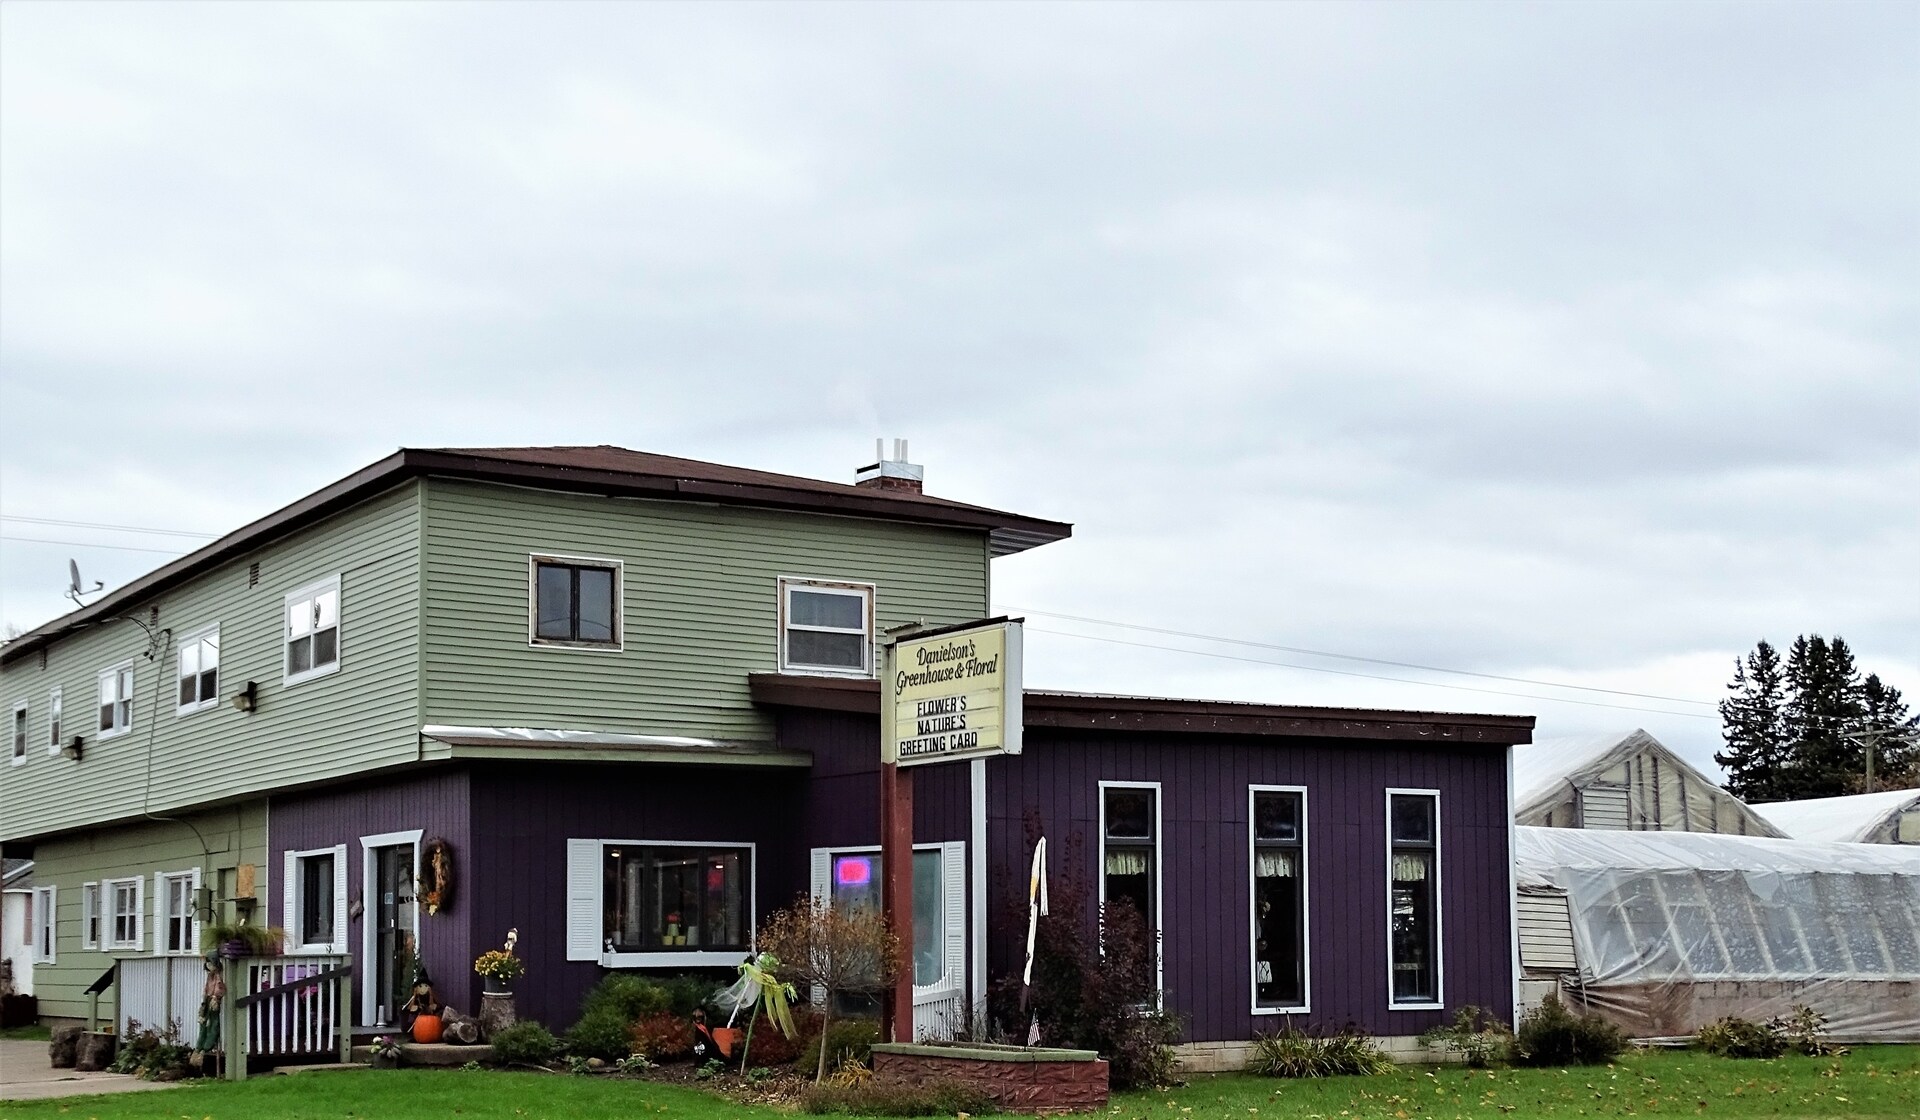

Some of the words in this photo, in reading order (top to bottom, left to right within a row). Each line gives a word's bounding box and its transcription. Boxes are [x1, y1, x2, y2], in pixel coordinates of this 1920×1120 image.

[916, 639, 976, 666] Danielson's
[896, 665, 954, 695] Greenhouse
[955, 662, 964, 679] &
[965, 653, 998, 678] Floral
[917, 695, 967, 717] FLOWER'S
[917, 714, 966, 736] NATURE'S
[900, 735, 946, 756] GREETING
[950, 731, 978, 750] CARD
